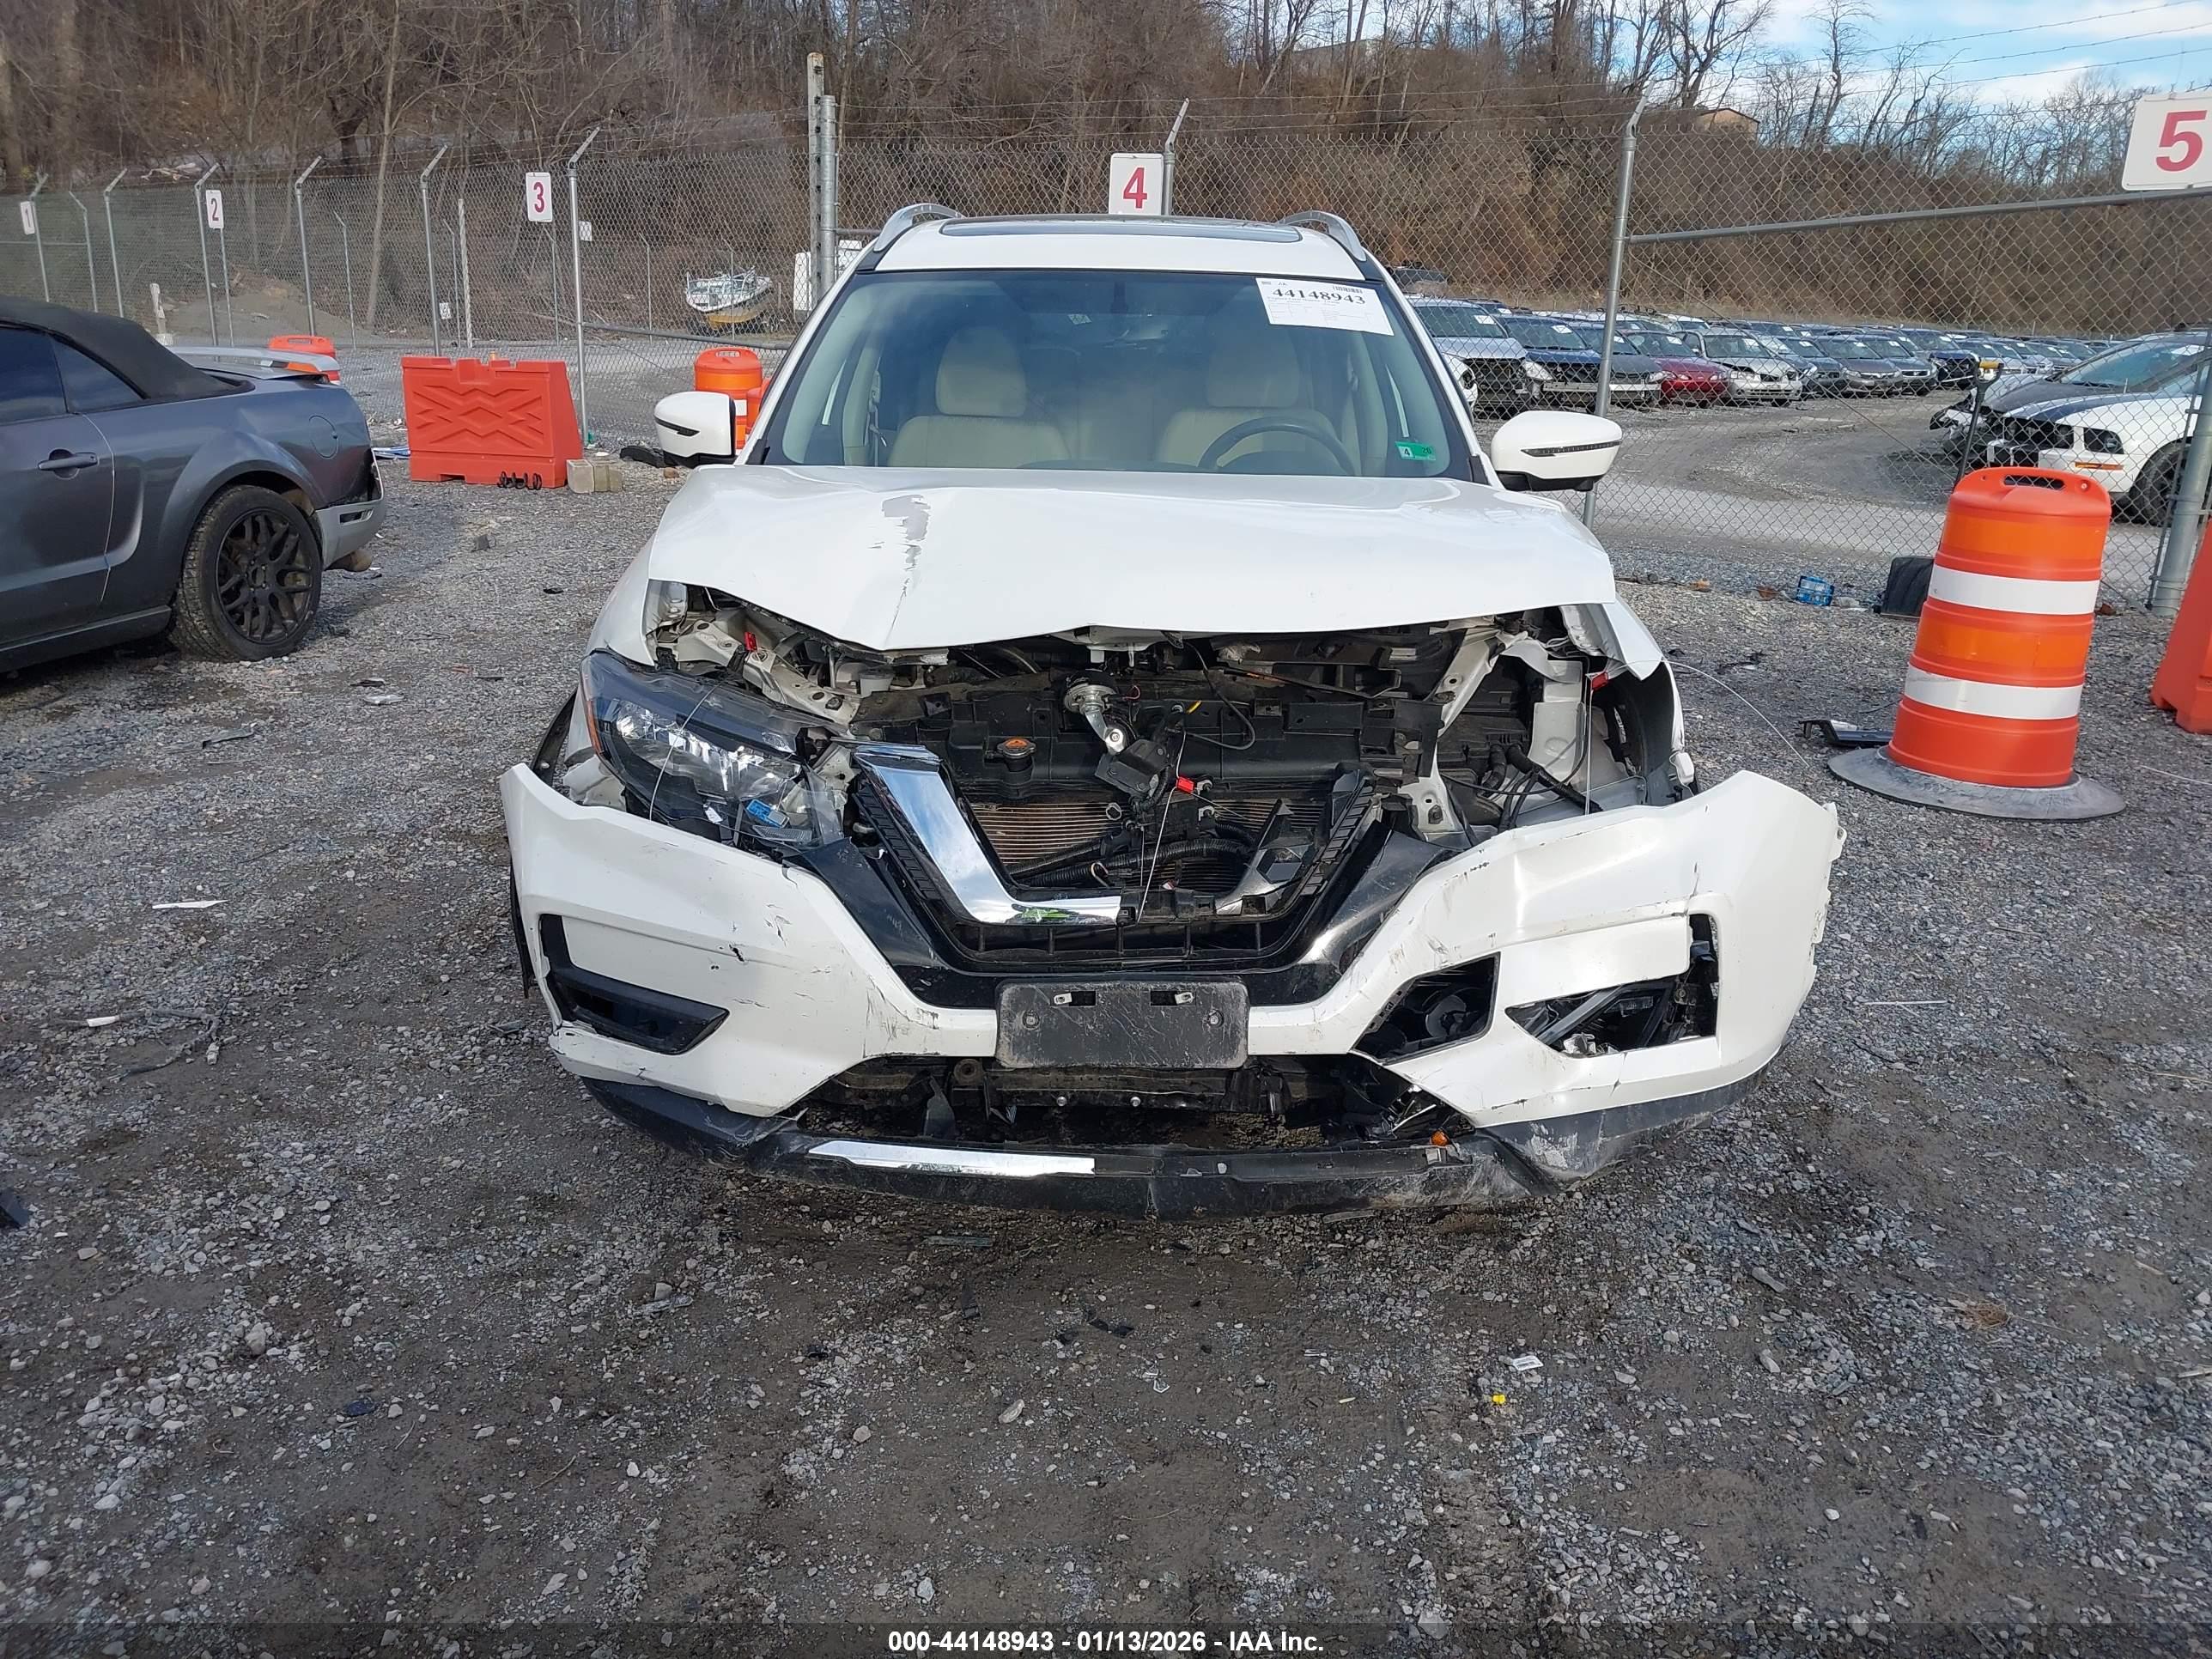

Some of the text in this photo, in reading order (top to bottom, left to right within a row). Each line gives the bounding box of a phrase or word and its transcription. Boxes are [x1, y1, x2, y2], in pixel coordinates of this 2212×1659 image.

[2156, 110, 2208, 172] 5
[533, 182, 544, 213] 3
[1123, 167, 1147, 209] 4
[211, 198, 219, 221] 2
[1273, 289, 1366, 305] 44148943
